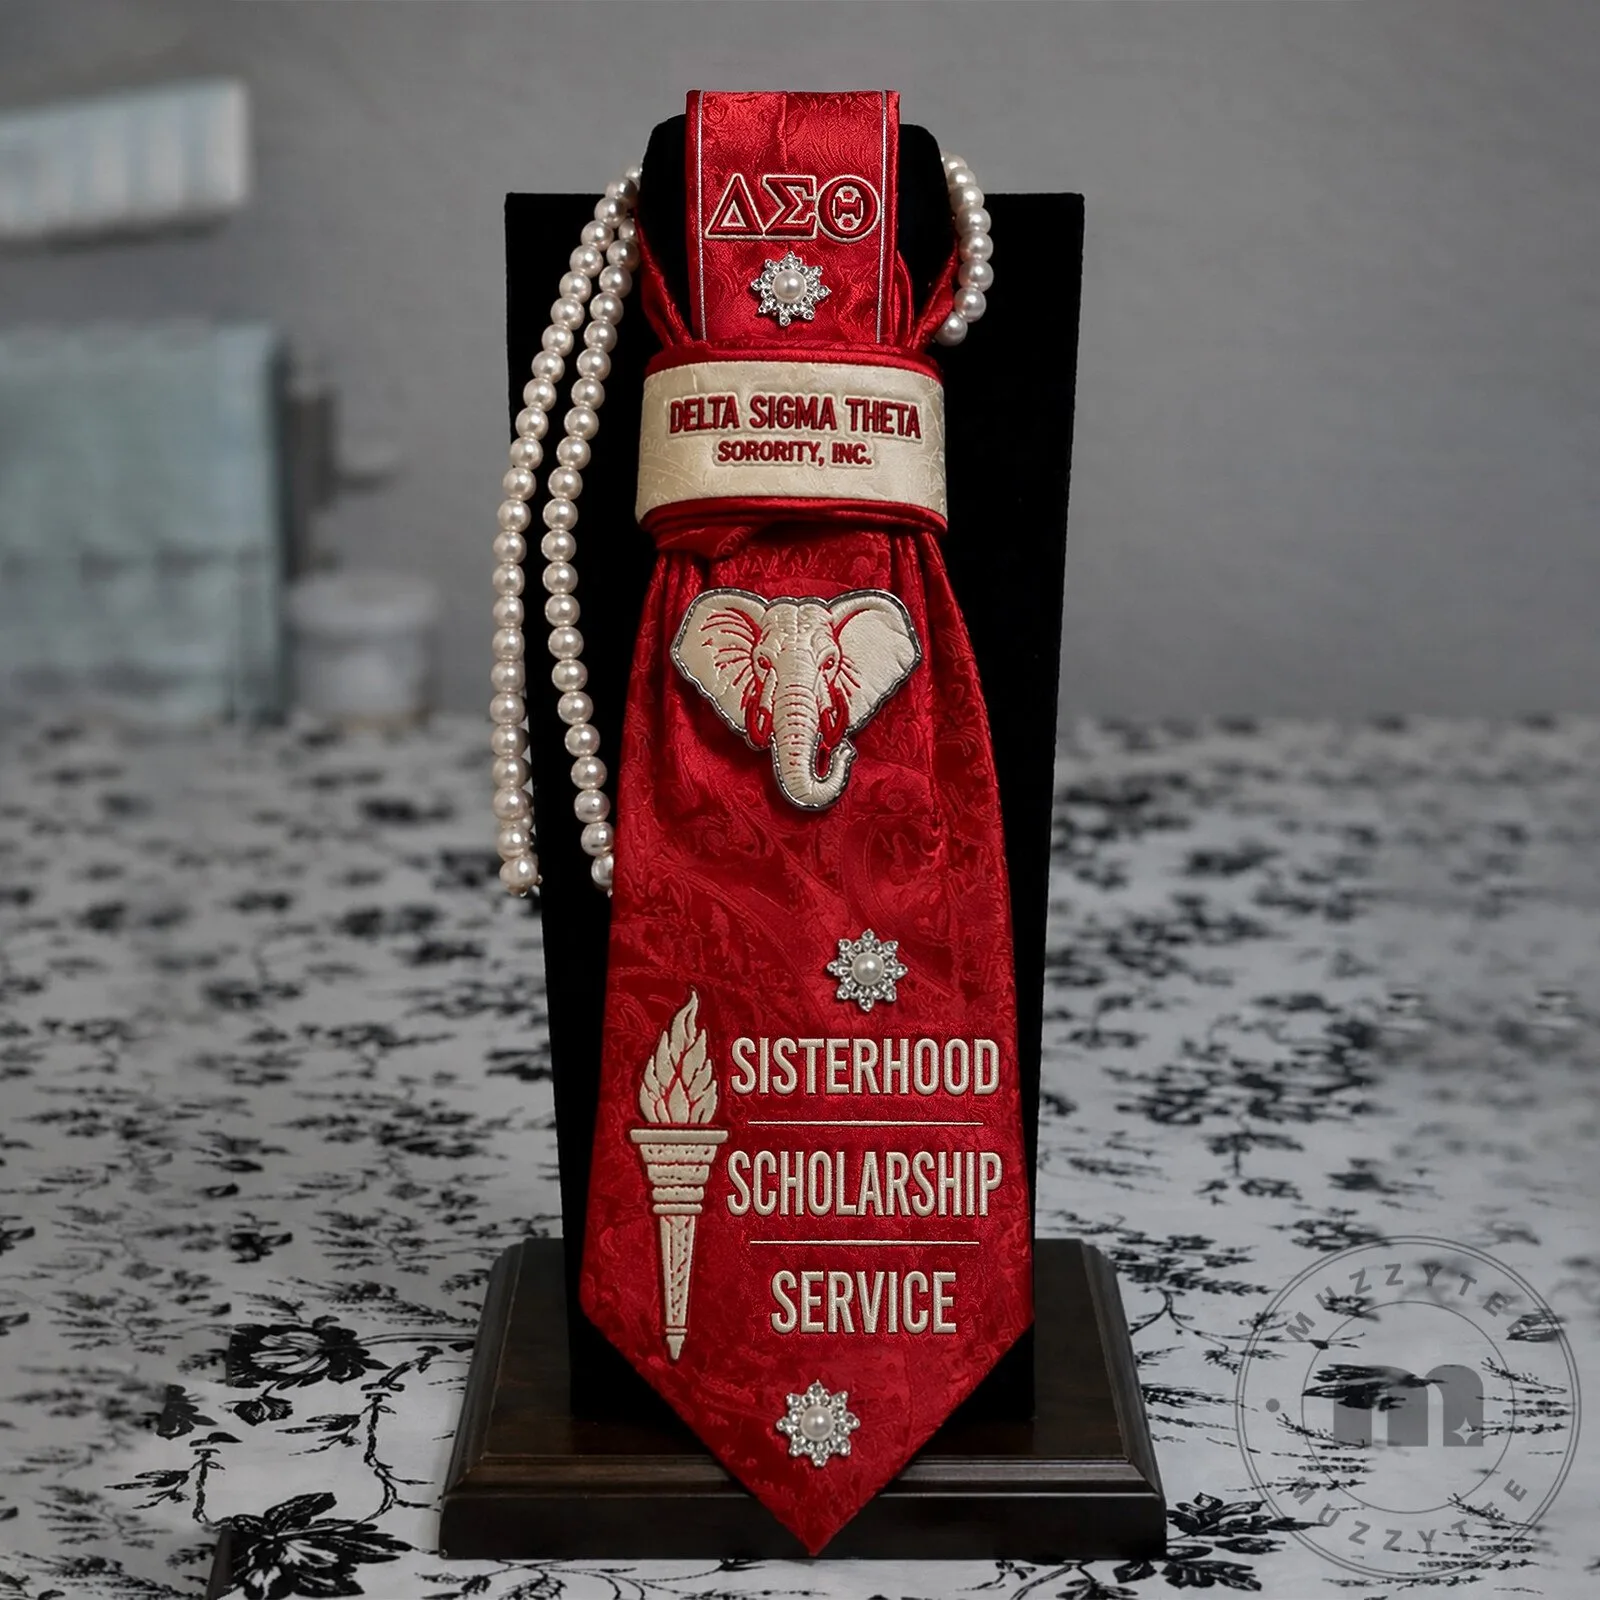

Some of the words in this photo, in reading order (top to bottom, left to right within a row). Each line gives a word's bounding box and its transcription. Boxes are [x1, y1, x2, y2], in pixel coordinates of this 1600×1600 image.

[705, 173, 881, 242] ΔΣΘ
[669, 395, 739, 434] DELTA
[749, 396, 837, 432] SIGMA
[845, 400, 921, 440] THETA
[717, 441, 825, 467] SORORITY,
[832, 442, 872, 465] INC.
[731, 1037, 999, 1095] SISTERHOOD
[727, 1150, 1003, 1217] SCHOLARSHIP
[771, 1270, 957, 1335] SERVICE
